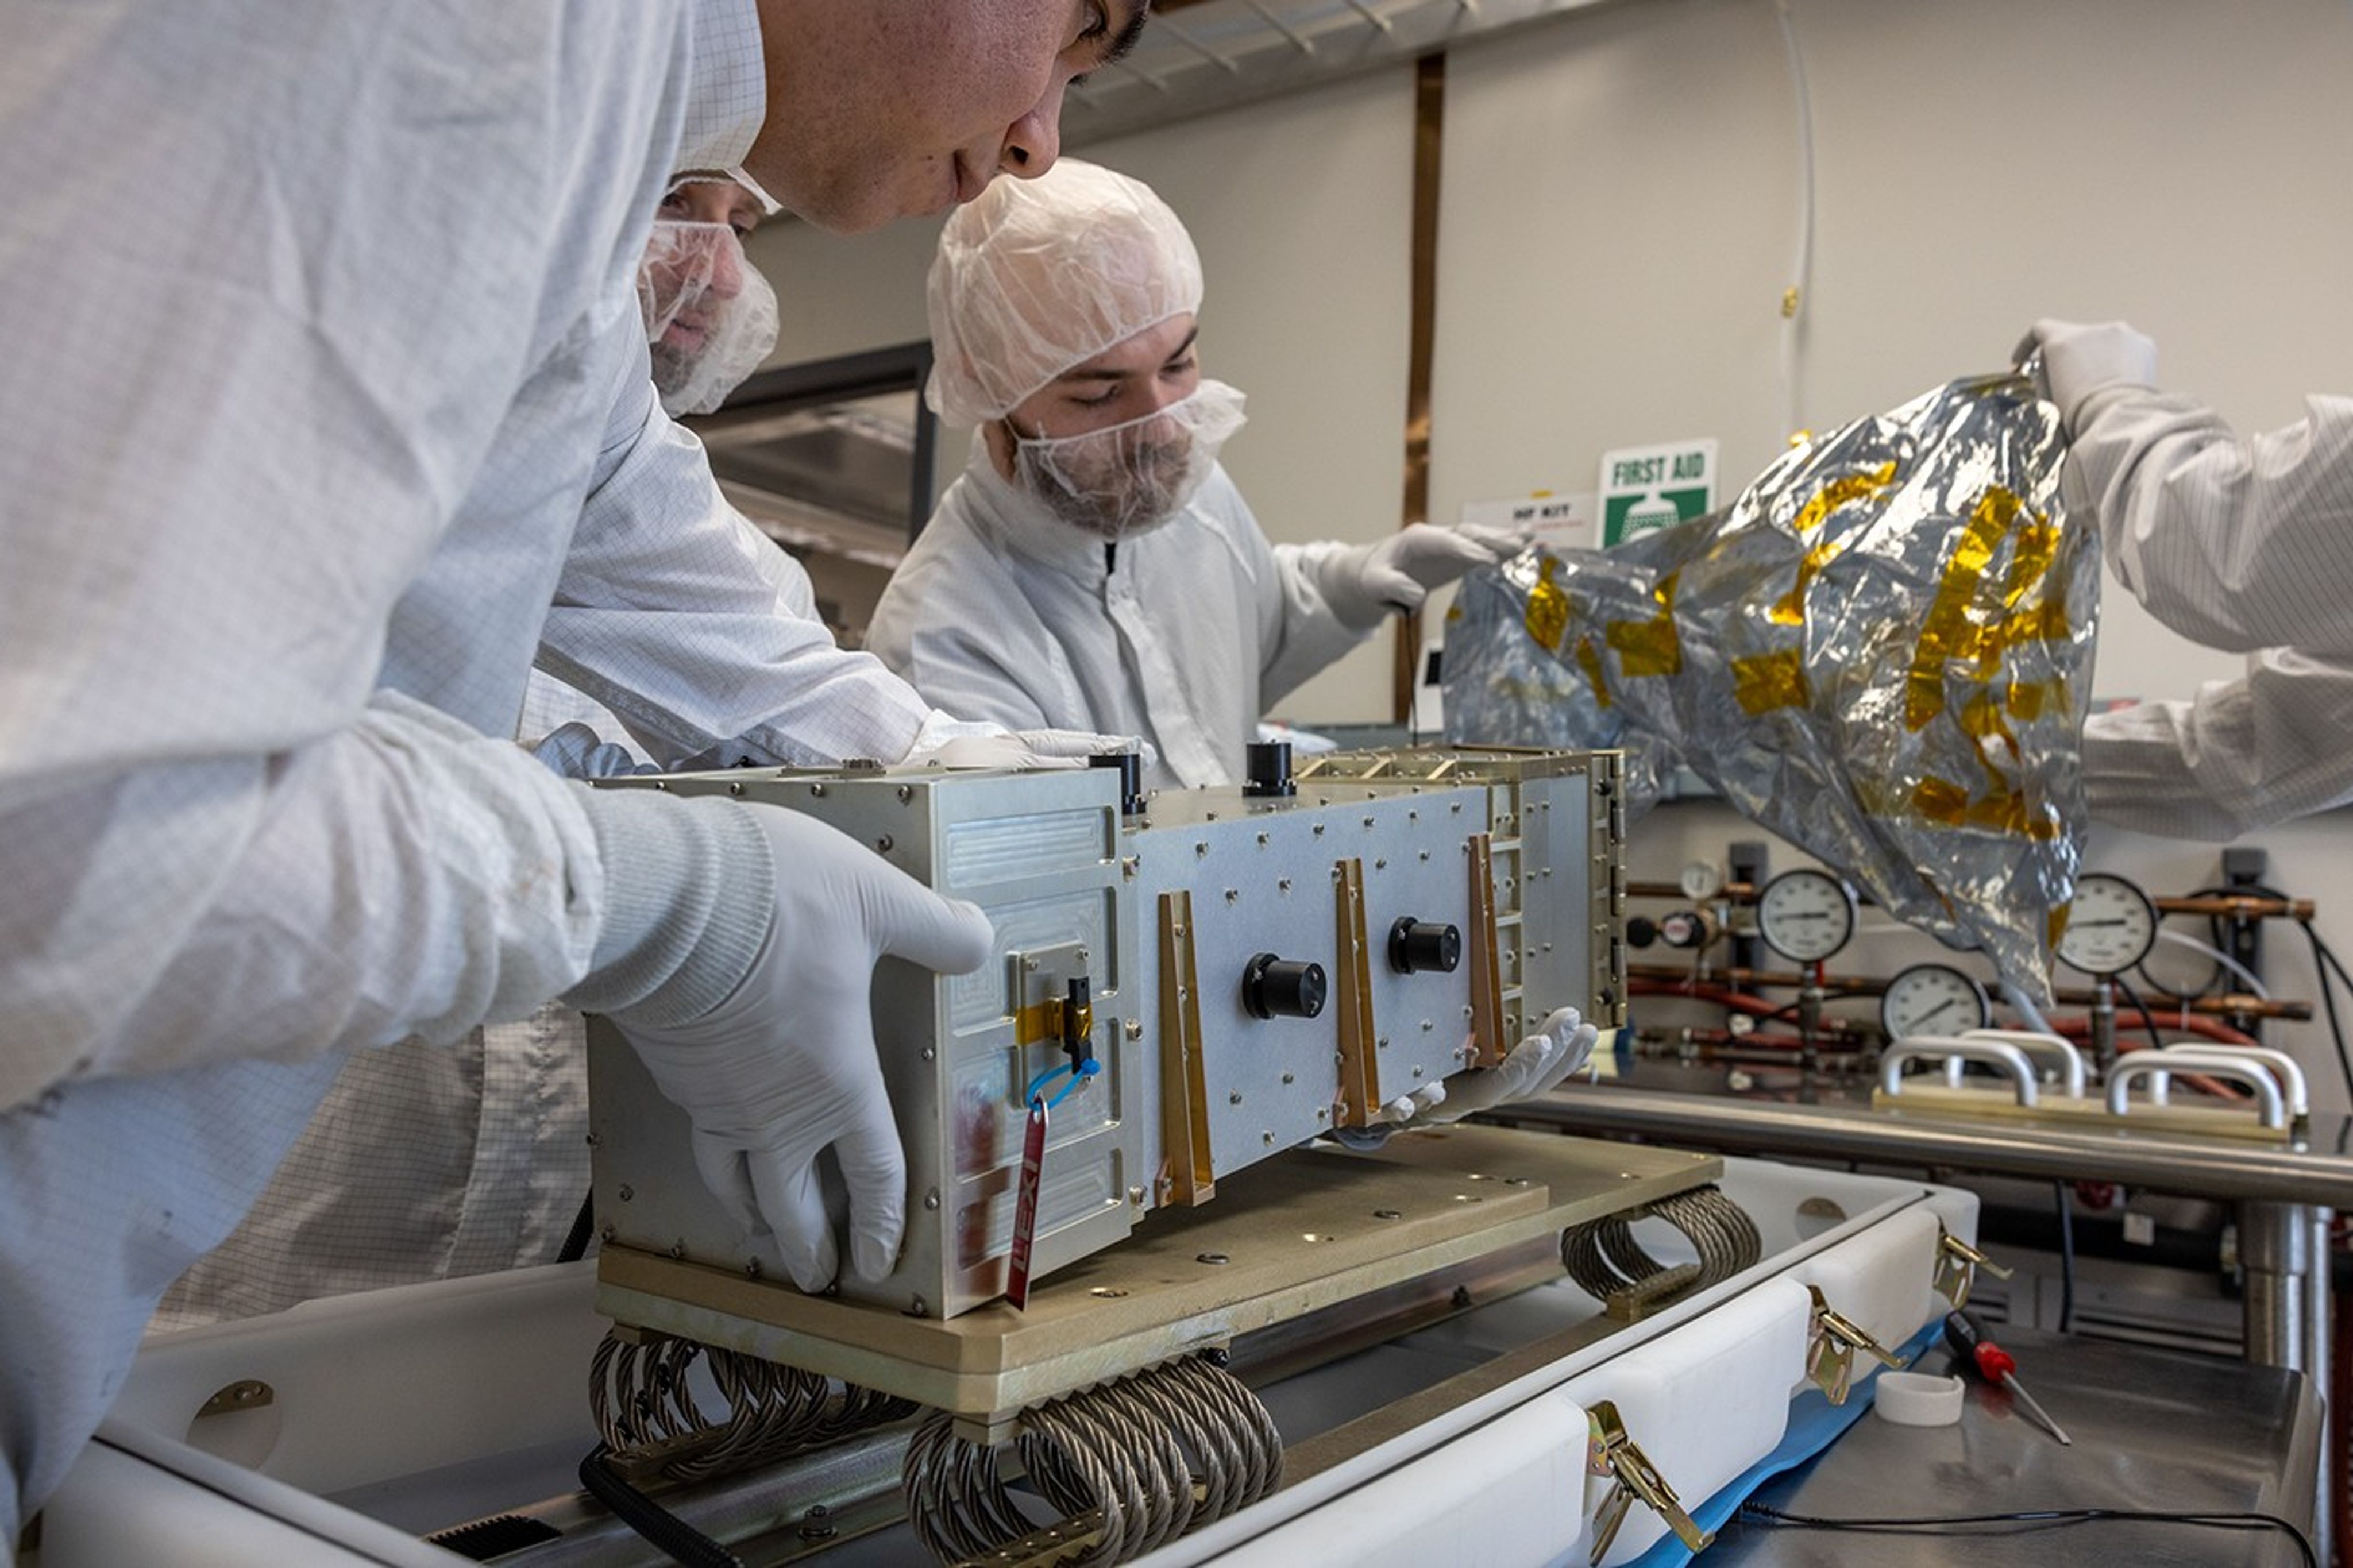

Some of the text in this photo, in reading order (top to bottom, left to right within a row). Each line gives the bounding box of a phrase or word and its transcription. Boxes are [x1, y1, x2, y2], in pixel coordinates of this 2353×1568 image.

[1613, 451, 1704, 487] FIRST AID
[1012, 1157, 1039, 1272] LEXI
